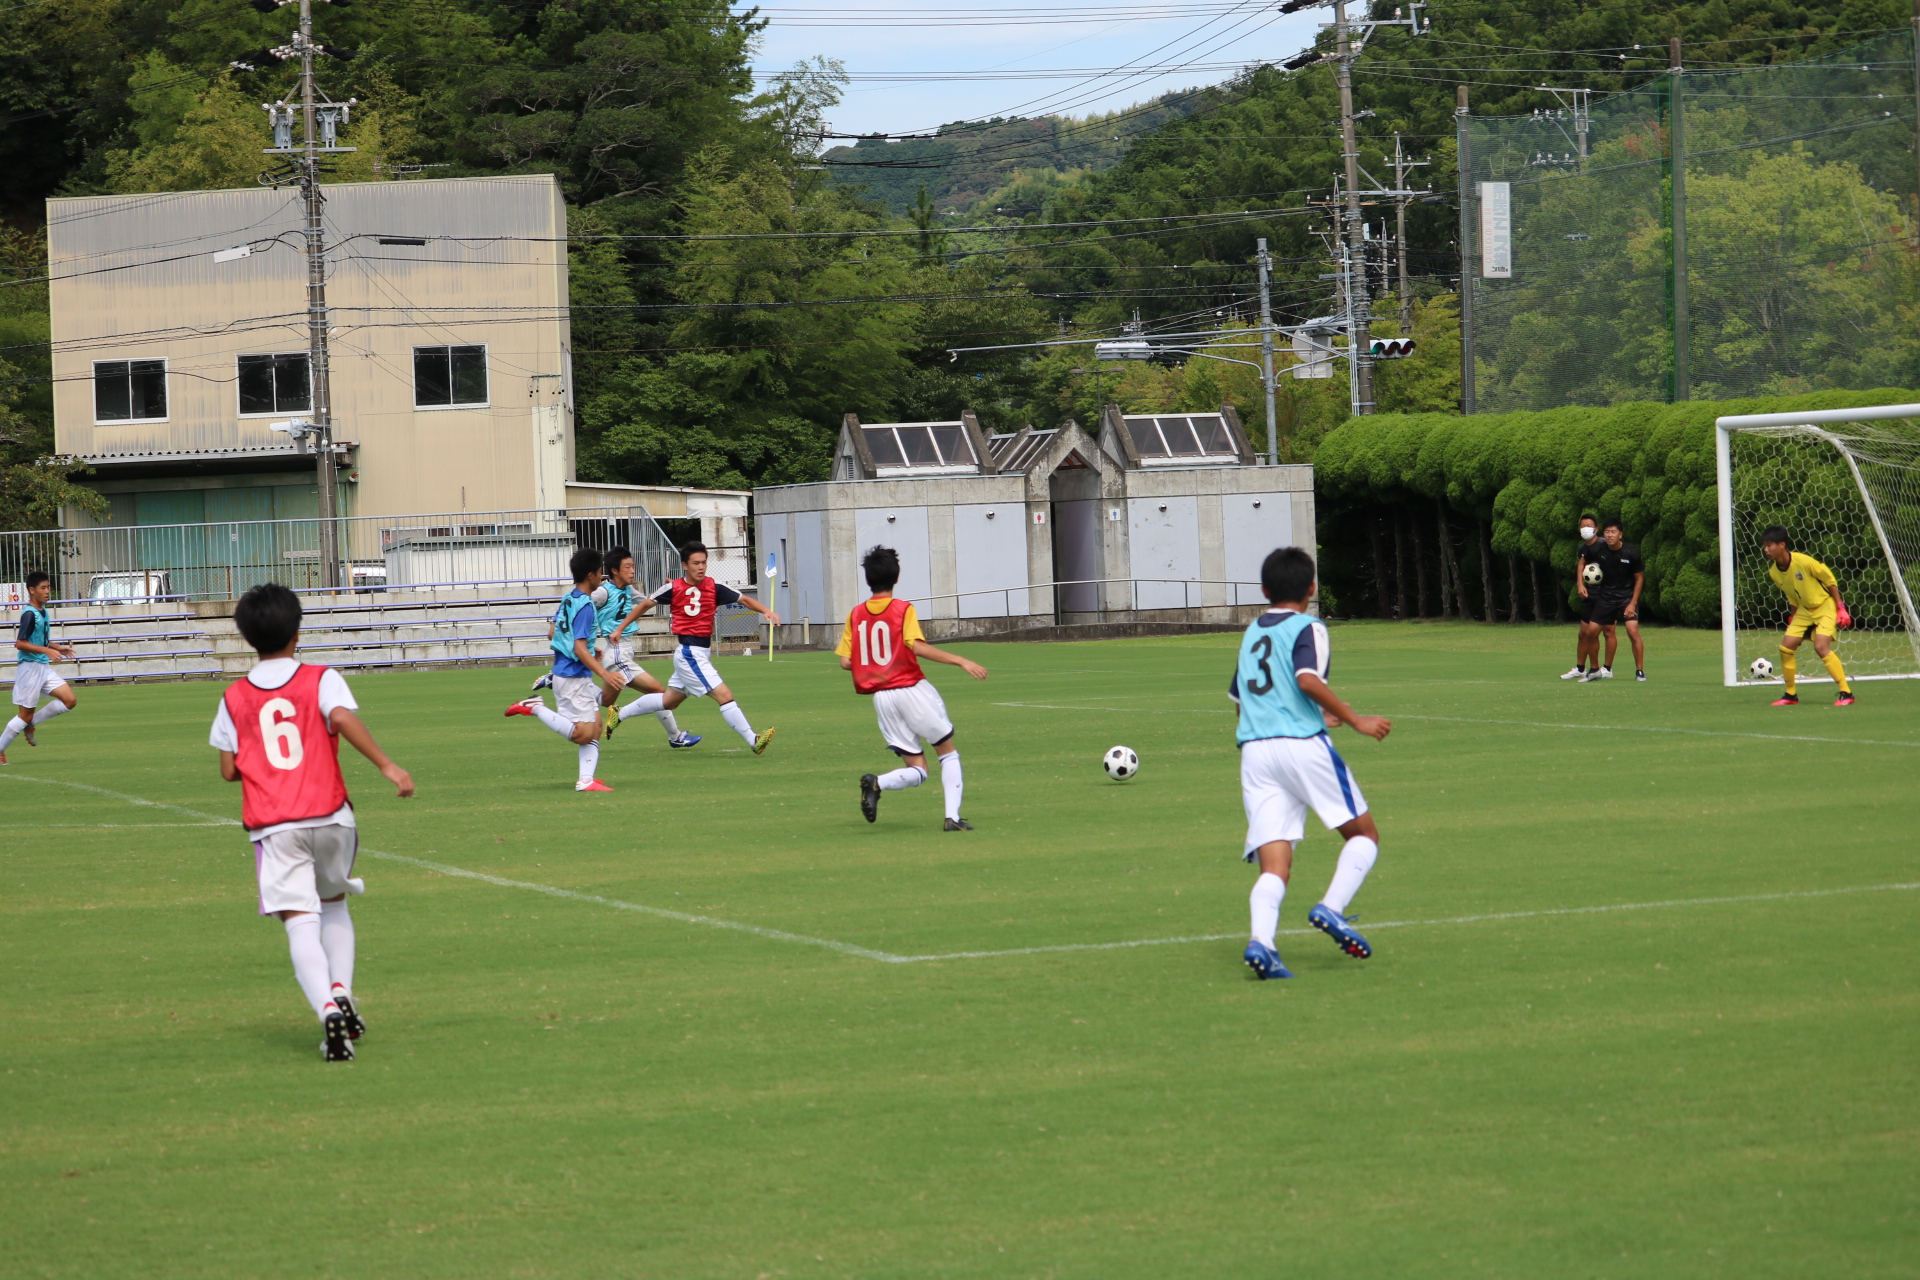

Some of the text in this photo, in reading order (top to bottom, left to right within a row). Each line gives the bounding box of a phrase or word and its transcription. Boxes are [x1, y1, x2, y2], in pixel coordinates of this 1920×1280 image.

[616, 593, 628, 620] 2
[683, 586, 702, 617] 3
[857, 620, 893, 667] 10
[1247, 634, 1274, 696] 3
[258, 697, 304, 771] 6
